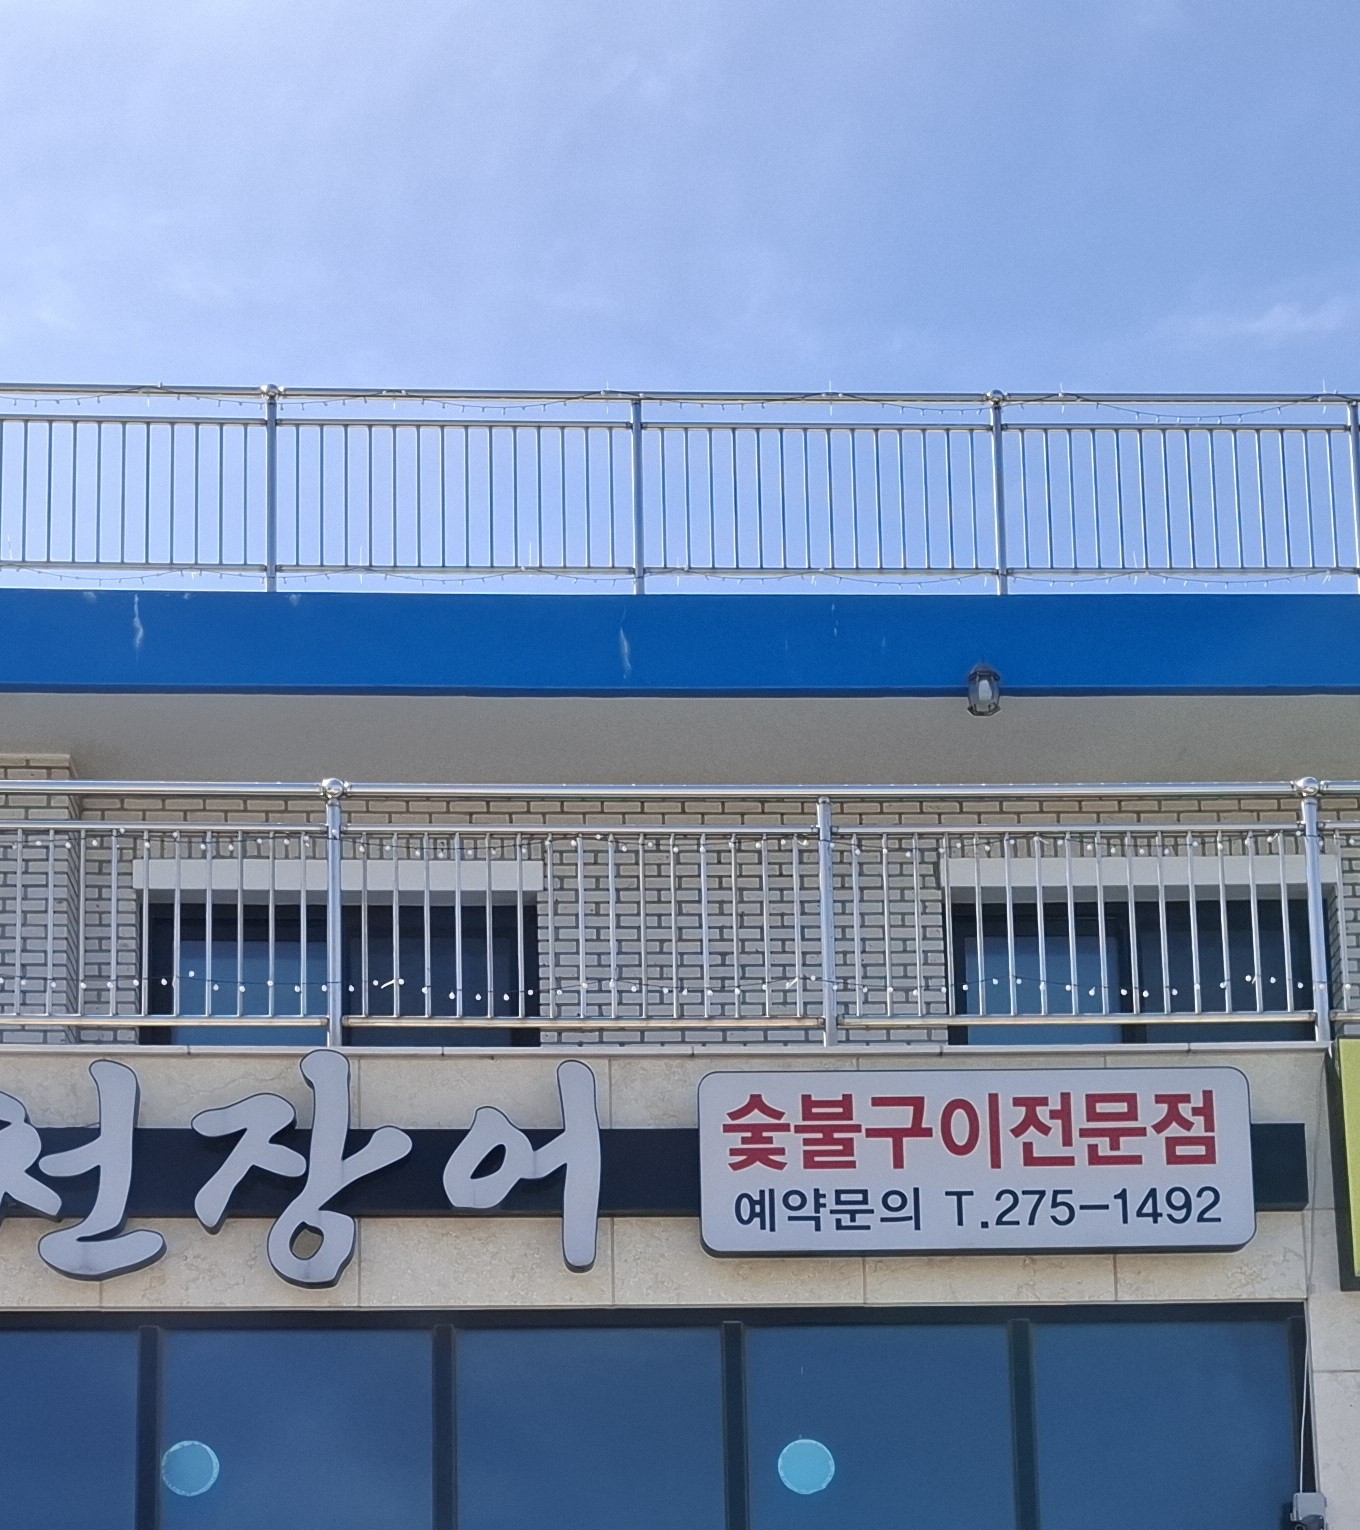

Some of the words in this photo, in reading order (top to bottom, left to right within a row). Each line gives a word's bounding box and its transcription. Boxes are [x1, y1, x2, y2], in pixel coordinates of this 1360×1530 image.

[722, 1089, 1217, 1171] 숯불구이전문점
[734, 1187, 922, 1232] 예약문의
[944, 1186, 1223, 1229] T.275-1492
